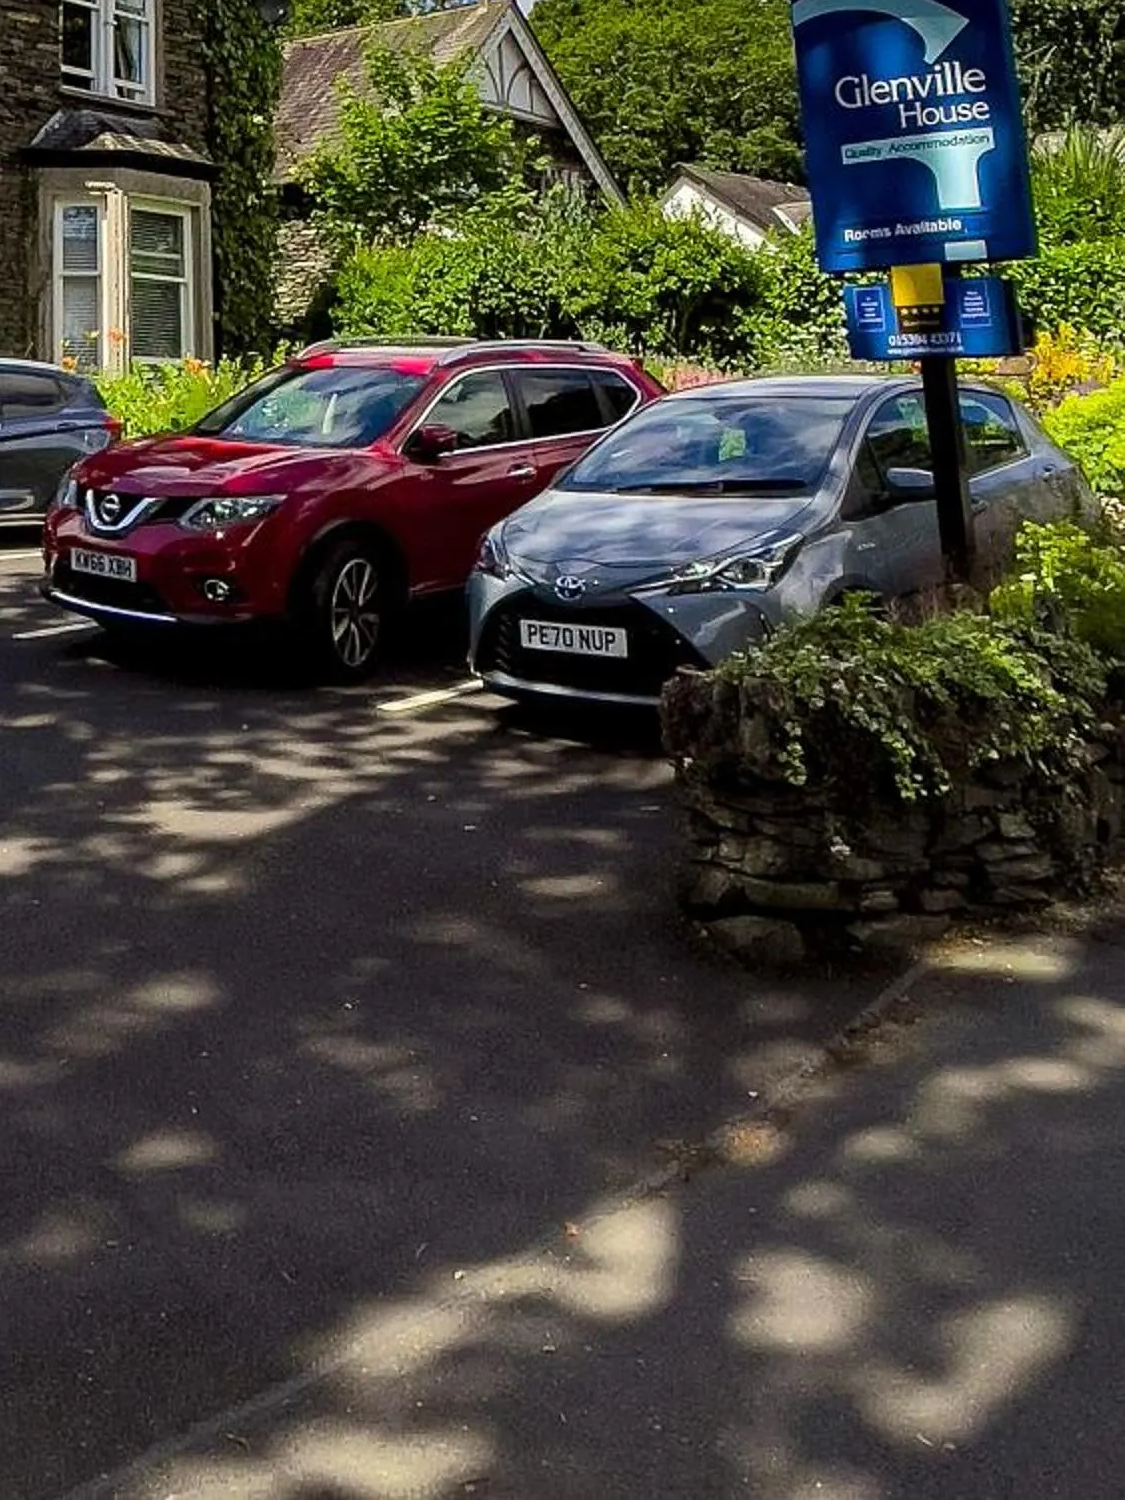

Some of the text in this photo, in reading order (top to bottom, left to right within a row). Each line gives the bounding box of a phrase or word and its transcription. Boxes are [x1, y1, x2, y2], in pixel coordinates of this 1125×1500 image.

[835, 60, 986, 108] Glenville
[899, 101, 990, 128] House
[844, 145, 882, 159] Quality
[888, 133, 990, 153] Accommodation
[844, 218, 962, 242] Rooms Available
[527, 624, 616, 652] PE70 NUP
